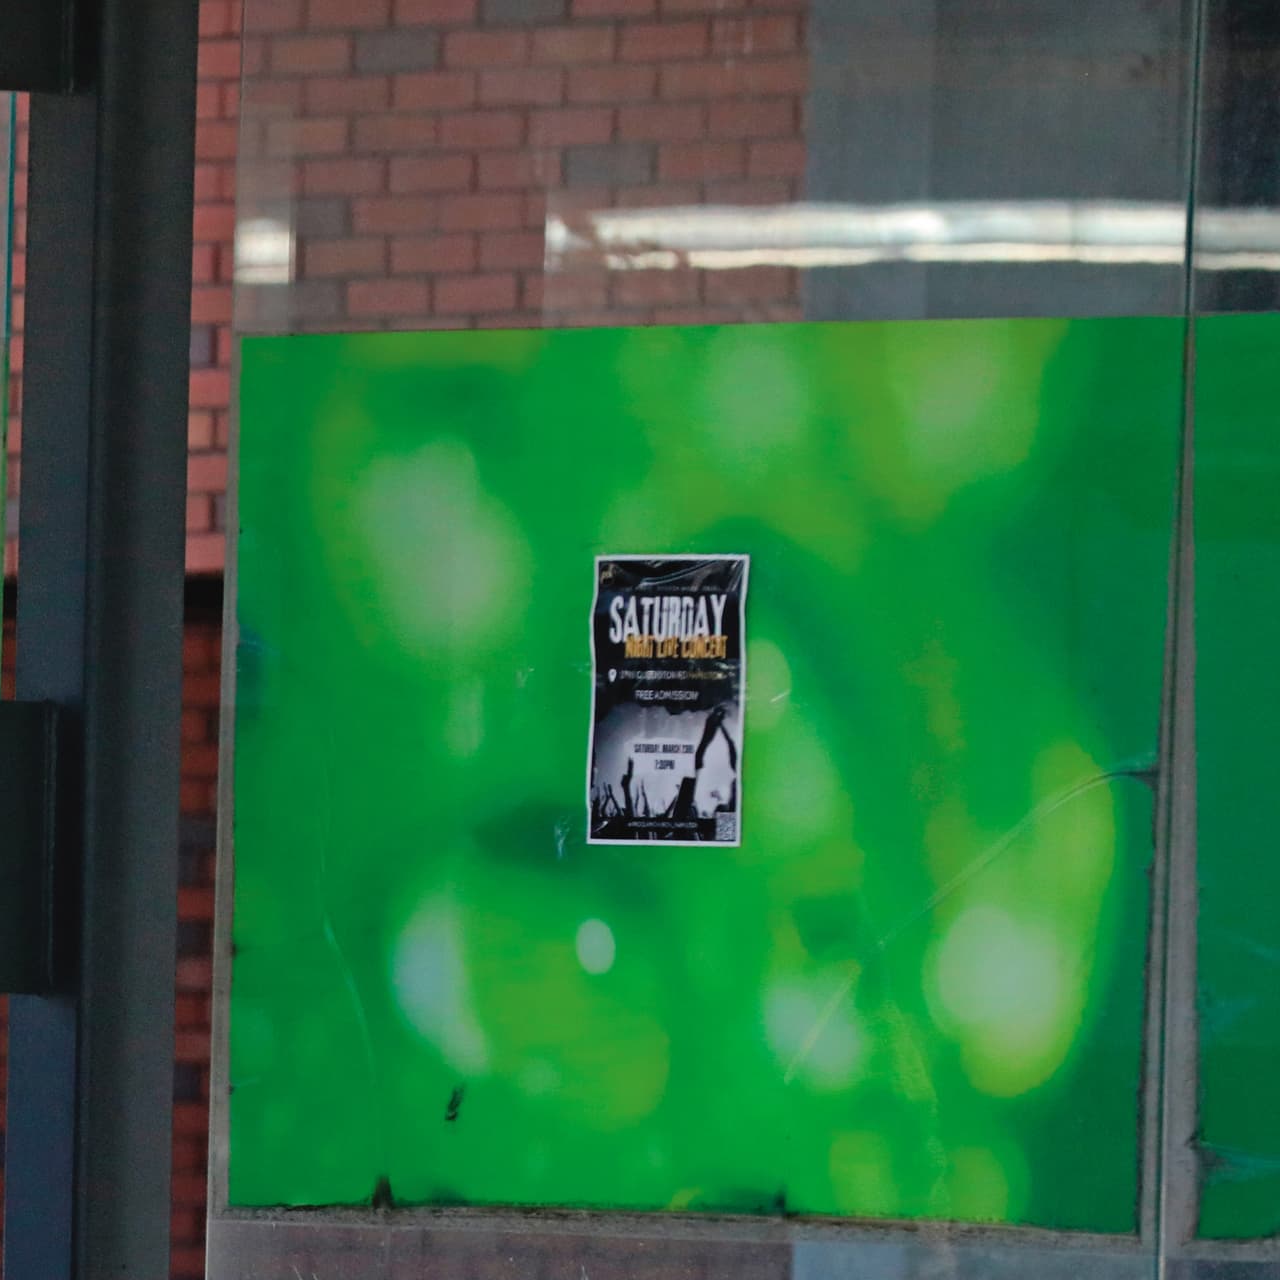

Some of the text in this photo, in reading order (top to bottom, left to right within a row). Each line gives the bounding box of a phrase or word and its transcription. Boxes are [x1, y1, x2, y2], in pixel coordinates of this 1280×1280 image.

[609, 594, 727, 645] SATURDAY
[656, 635, 680, 658] LIVE
[681, 635, 728, 659] CONCERT
[635, 690, 654, 700] FREE
